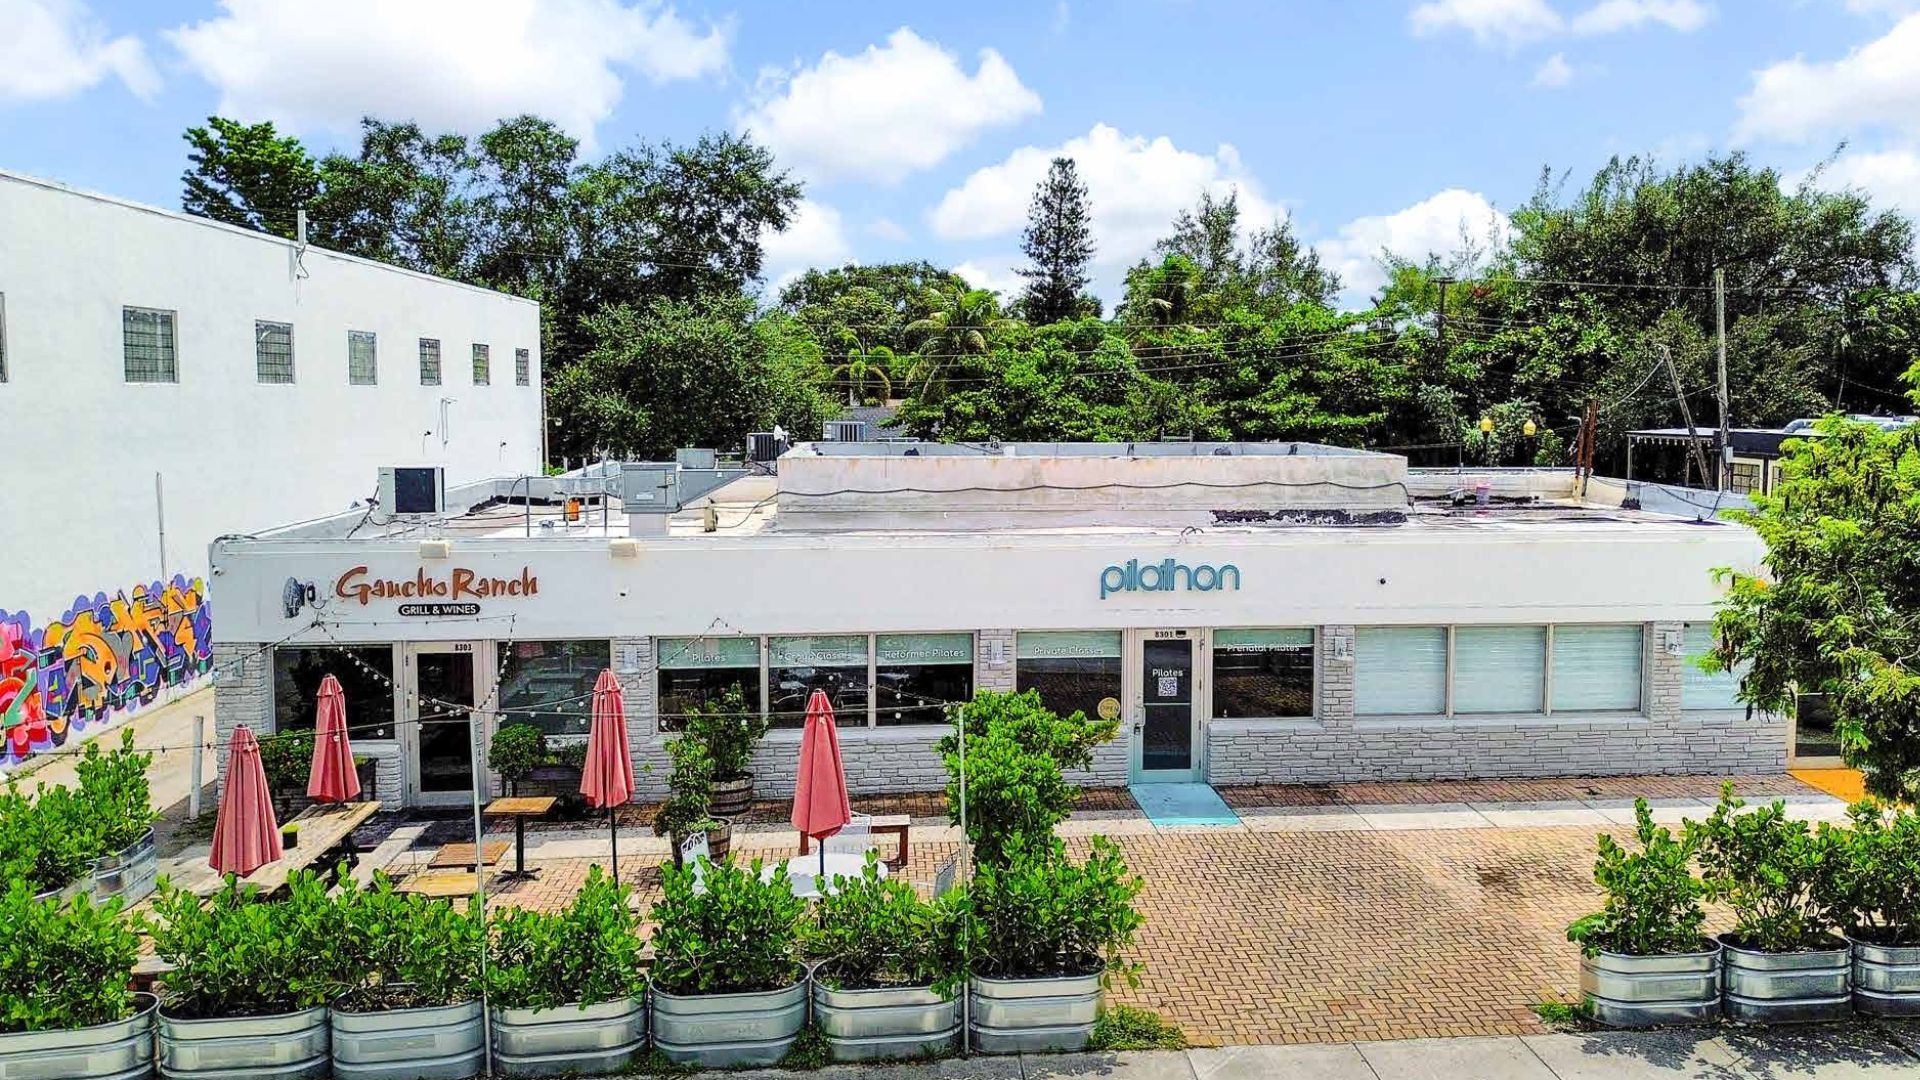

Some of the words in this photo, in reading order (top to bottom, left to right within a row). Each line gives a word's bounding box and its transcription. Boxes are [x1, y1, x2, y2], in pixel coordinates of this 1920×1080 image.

[1100, 558, 1240, 600] pilathon
[336, 566, 447, 606] Gaucho
[453, 566, 538, 600] Ranch
[401, 605, 430, 615] GRILL
[432, 605, 440, 615] &
[442, 605, 477, 614] WINES
[454, 643, 472, 651] 8303
[1034, 646, 1067, 655] Private
[692, 653, 726, 663] Pilates
[884, 649, 931, 659] Reformer
[932, 648, 965, 658] Pilates
[1152, 668, 1184, 677] Pilates
